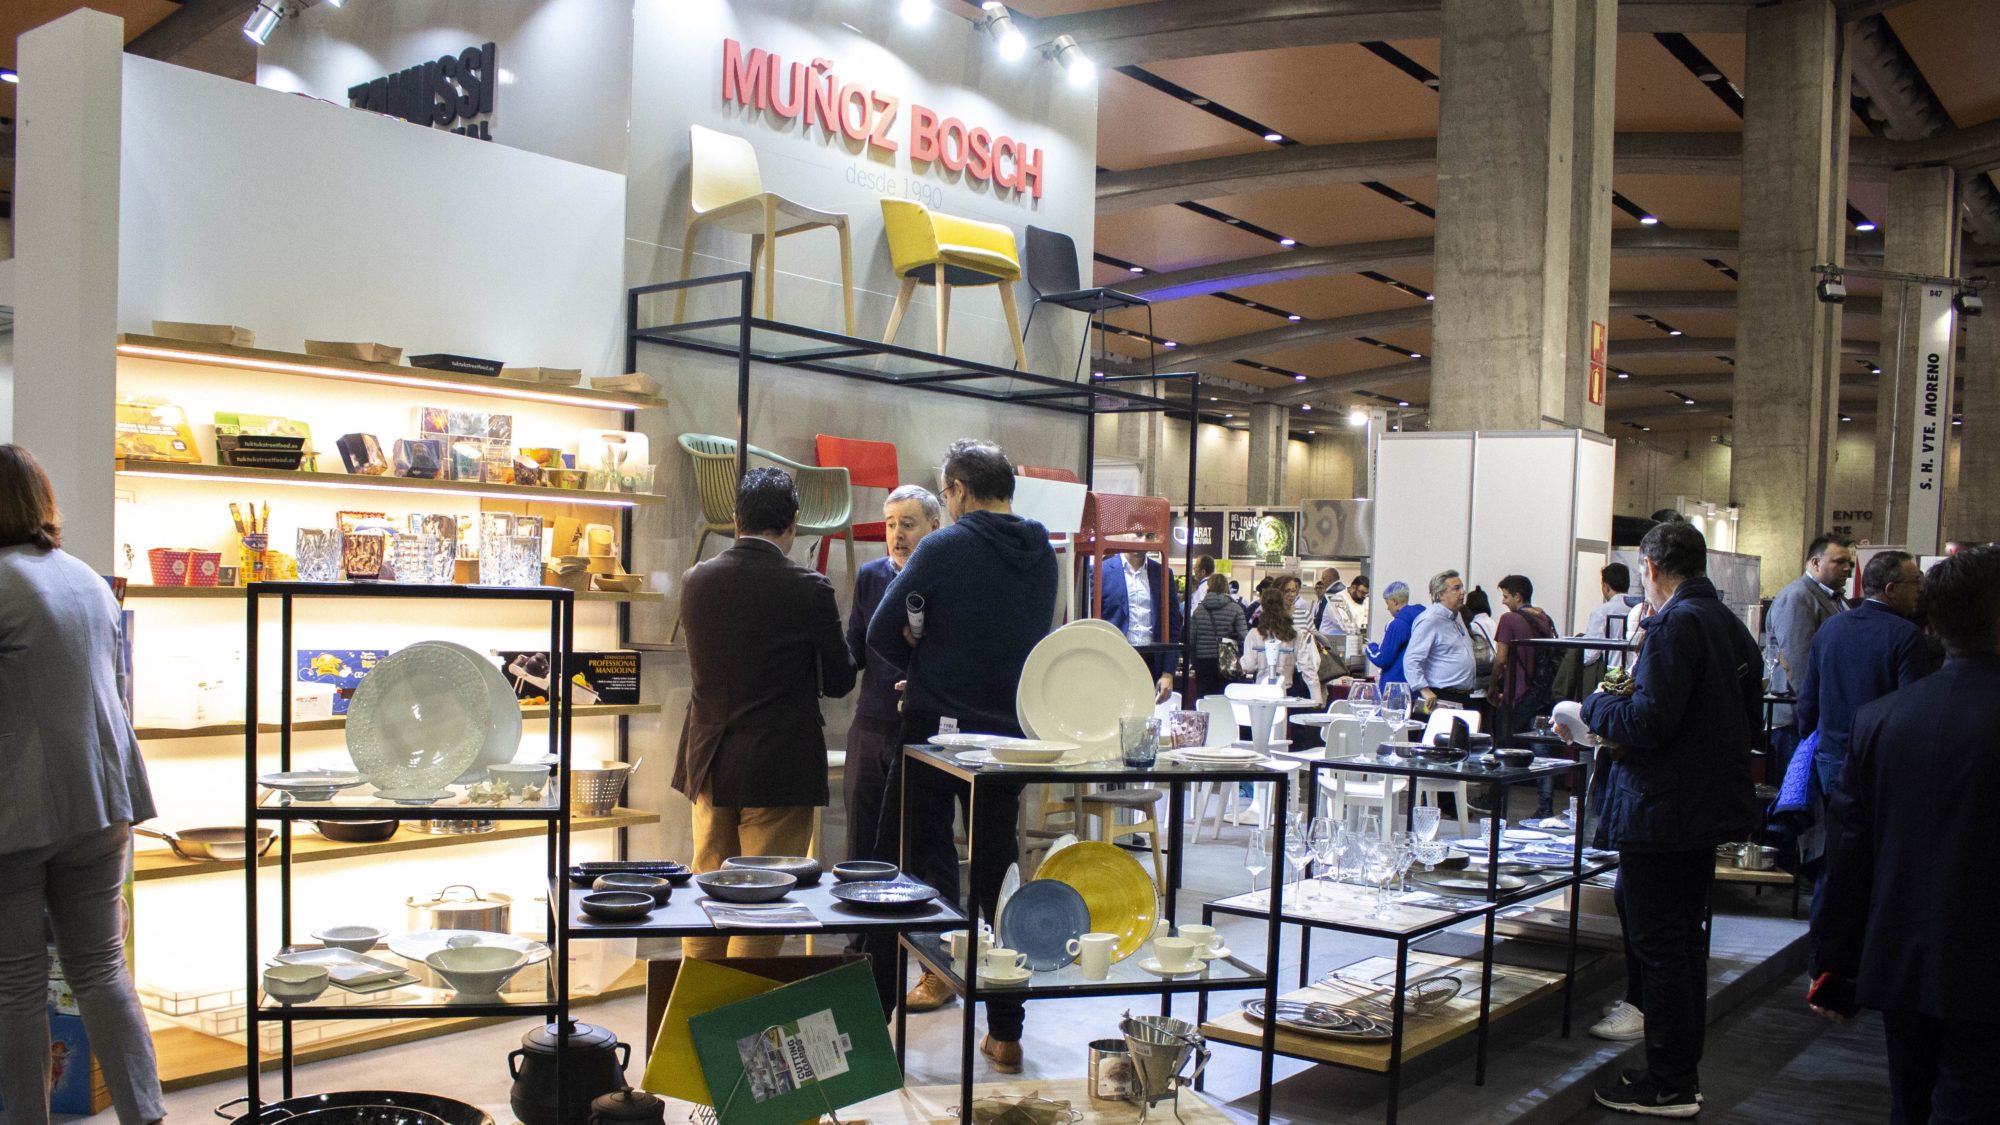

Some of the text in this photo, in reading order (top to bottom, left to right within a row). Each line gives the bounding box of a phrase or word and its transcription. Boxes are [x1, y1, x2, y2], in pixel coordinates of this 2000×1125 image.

[722, 38, 1044, 199] MUÑOZ BOSCH
[846, 162, 943, 209] desde 1990
[1920, 353, 1940, 490] S. H. VTE. MORENO
[1231, 528, 1247, 541] PLAT
[1239, 516, 1258, 531] TROS
[787, 1039, 805, 1079] CUTTING
